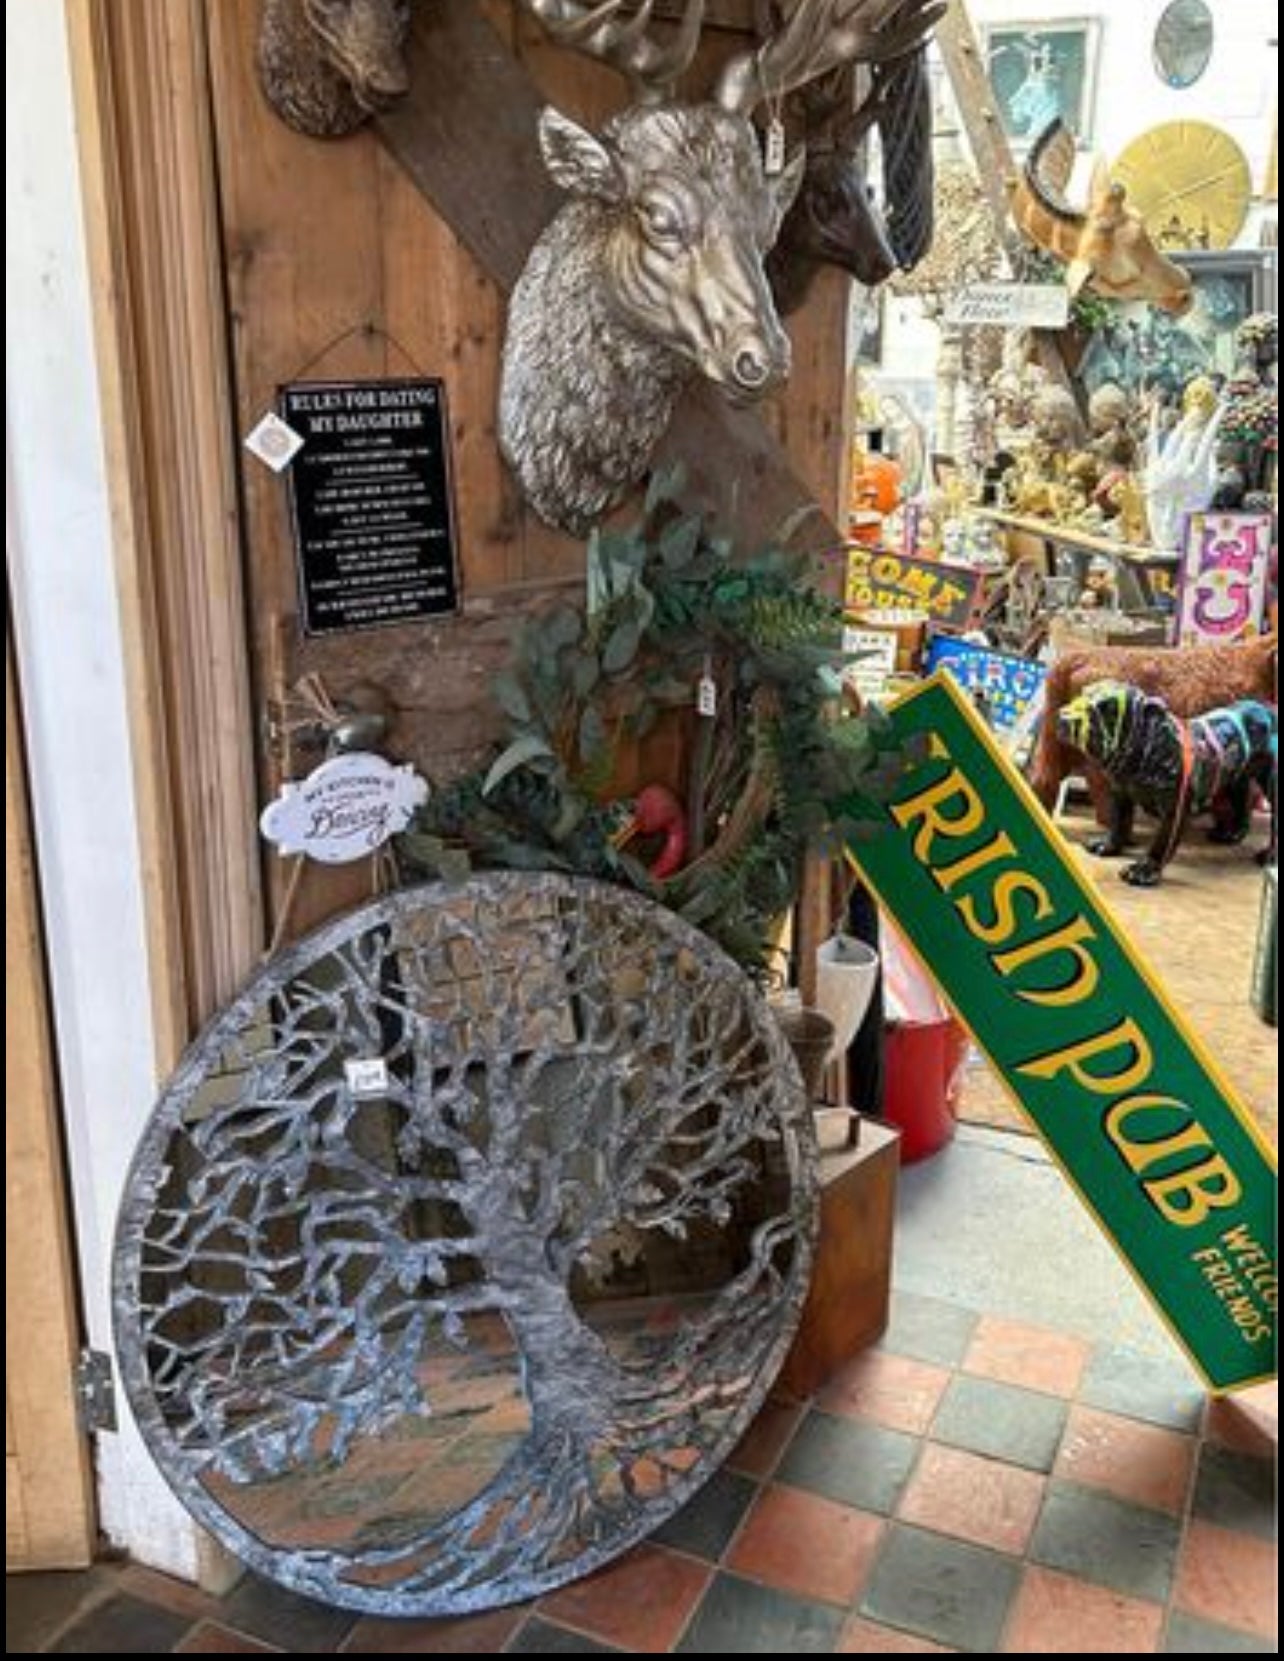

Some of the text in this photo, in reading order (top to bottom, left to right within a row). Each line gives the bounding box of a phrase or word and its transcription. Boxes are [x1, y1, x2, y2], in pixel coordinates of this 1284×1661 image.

[307, 411, 423, 433] MY DAUGHTER
[346, 390, 376, 408] FOR
[379, 387, 436, 408] DATING
[1014, 1016, 1242, 1226] PUB
[1191, 1247, 1271, 1342] FRIENDS
